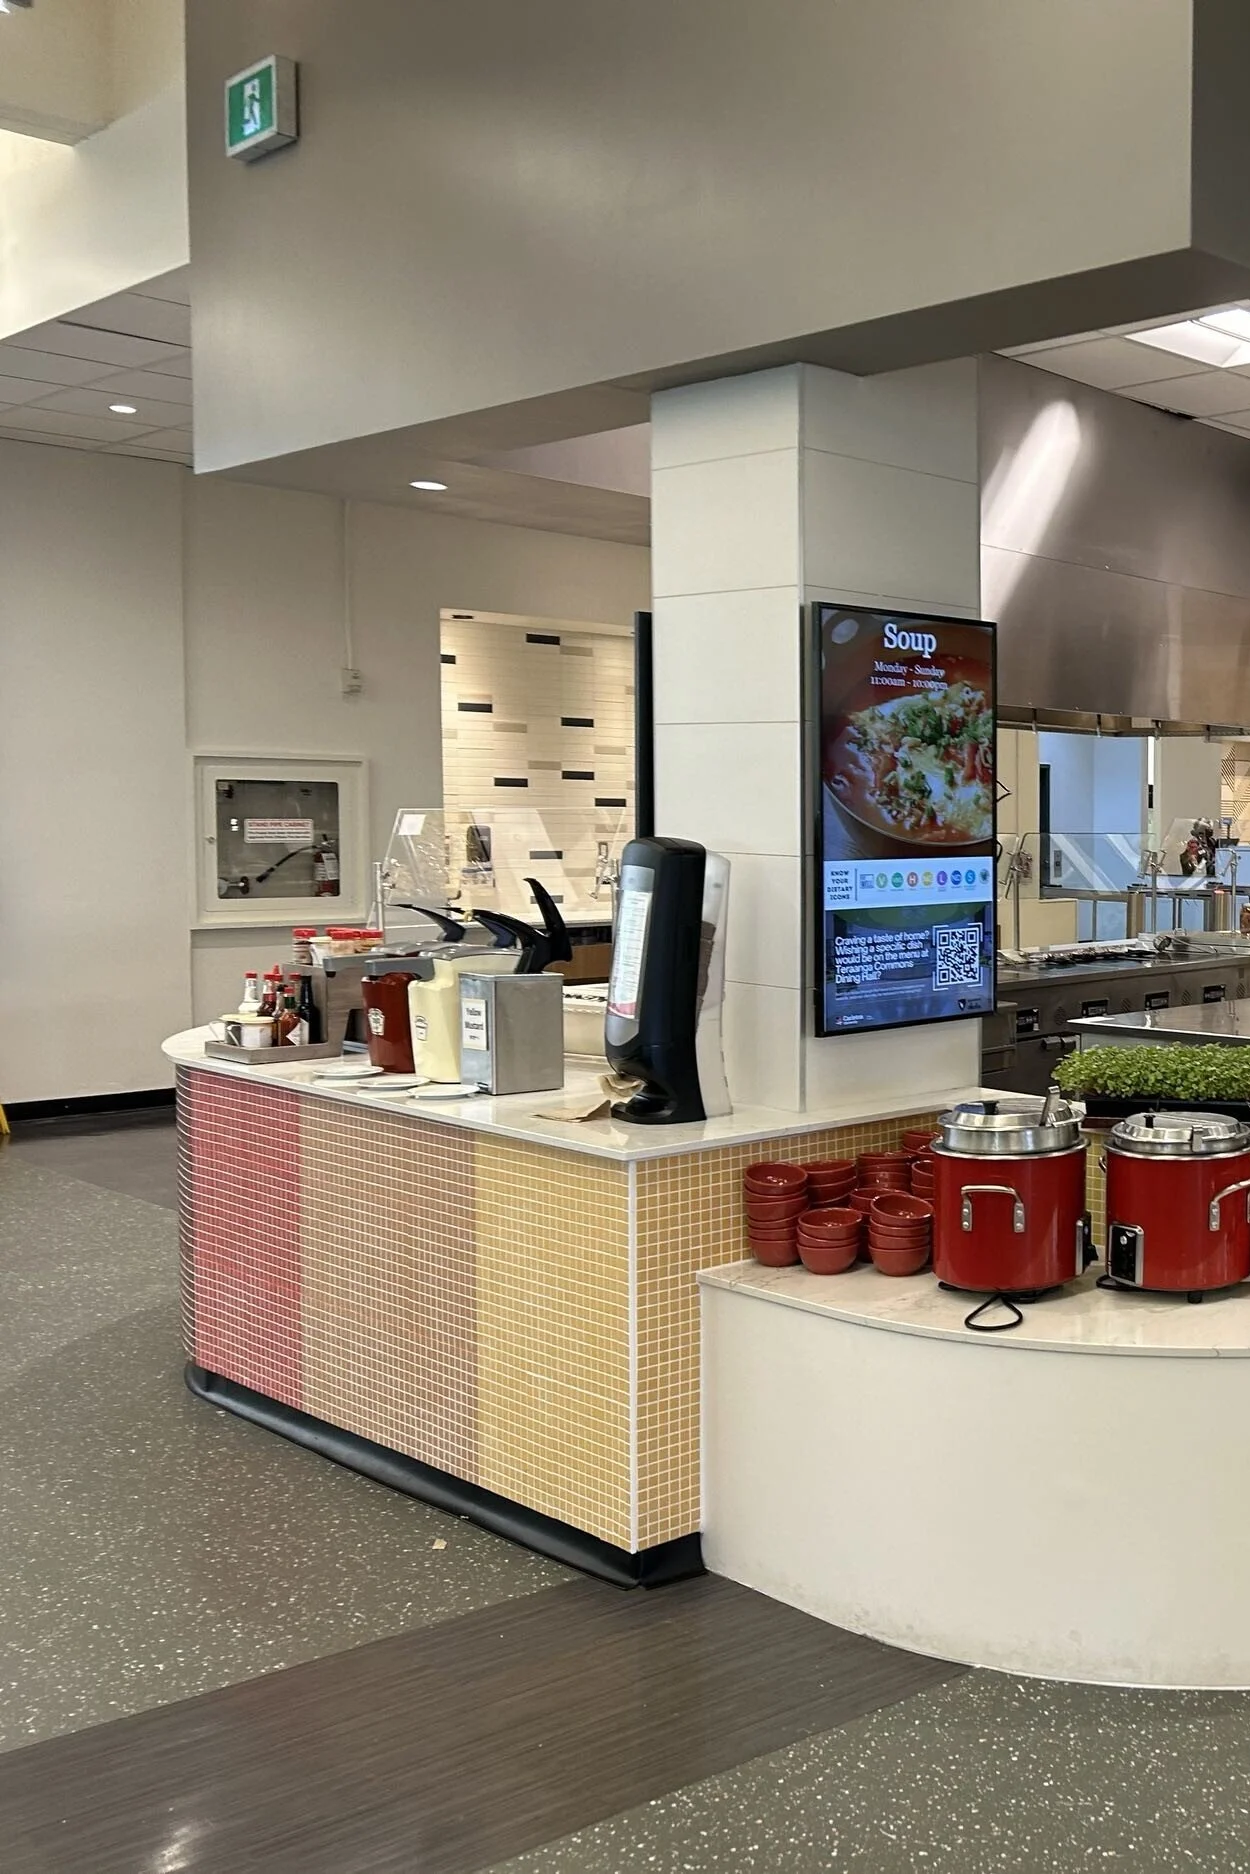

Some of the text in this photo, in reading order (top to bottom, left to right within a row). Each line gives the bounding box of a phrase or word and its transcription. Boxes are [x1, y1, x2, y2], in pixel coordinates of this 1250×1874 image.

[884, 623, 937, 659] Soup
[874, 661, 908, 676] Monday
[914, 664, 946, 678] Sunday
[835, 936, 866, 946] Craving
[873, 934, 893, 943] taste
[894, 932, 903, 941] of
[904, 930, 930, 940] home?
[835, 945, 868, 956] Wishing
[876, 942, 906, 953] specific
[907, 941, 923, 950] dish
[835, 955, 860, 964] would
[862, 954, 872, 962] be
[885, 952, 898, 960] the
[899, 951, 920, 959] menu
[921, 949, 929, 957] at
[874, 960, 914, 970] Commons
[835, 971, 882, 984] Dining Hall?
